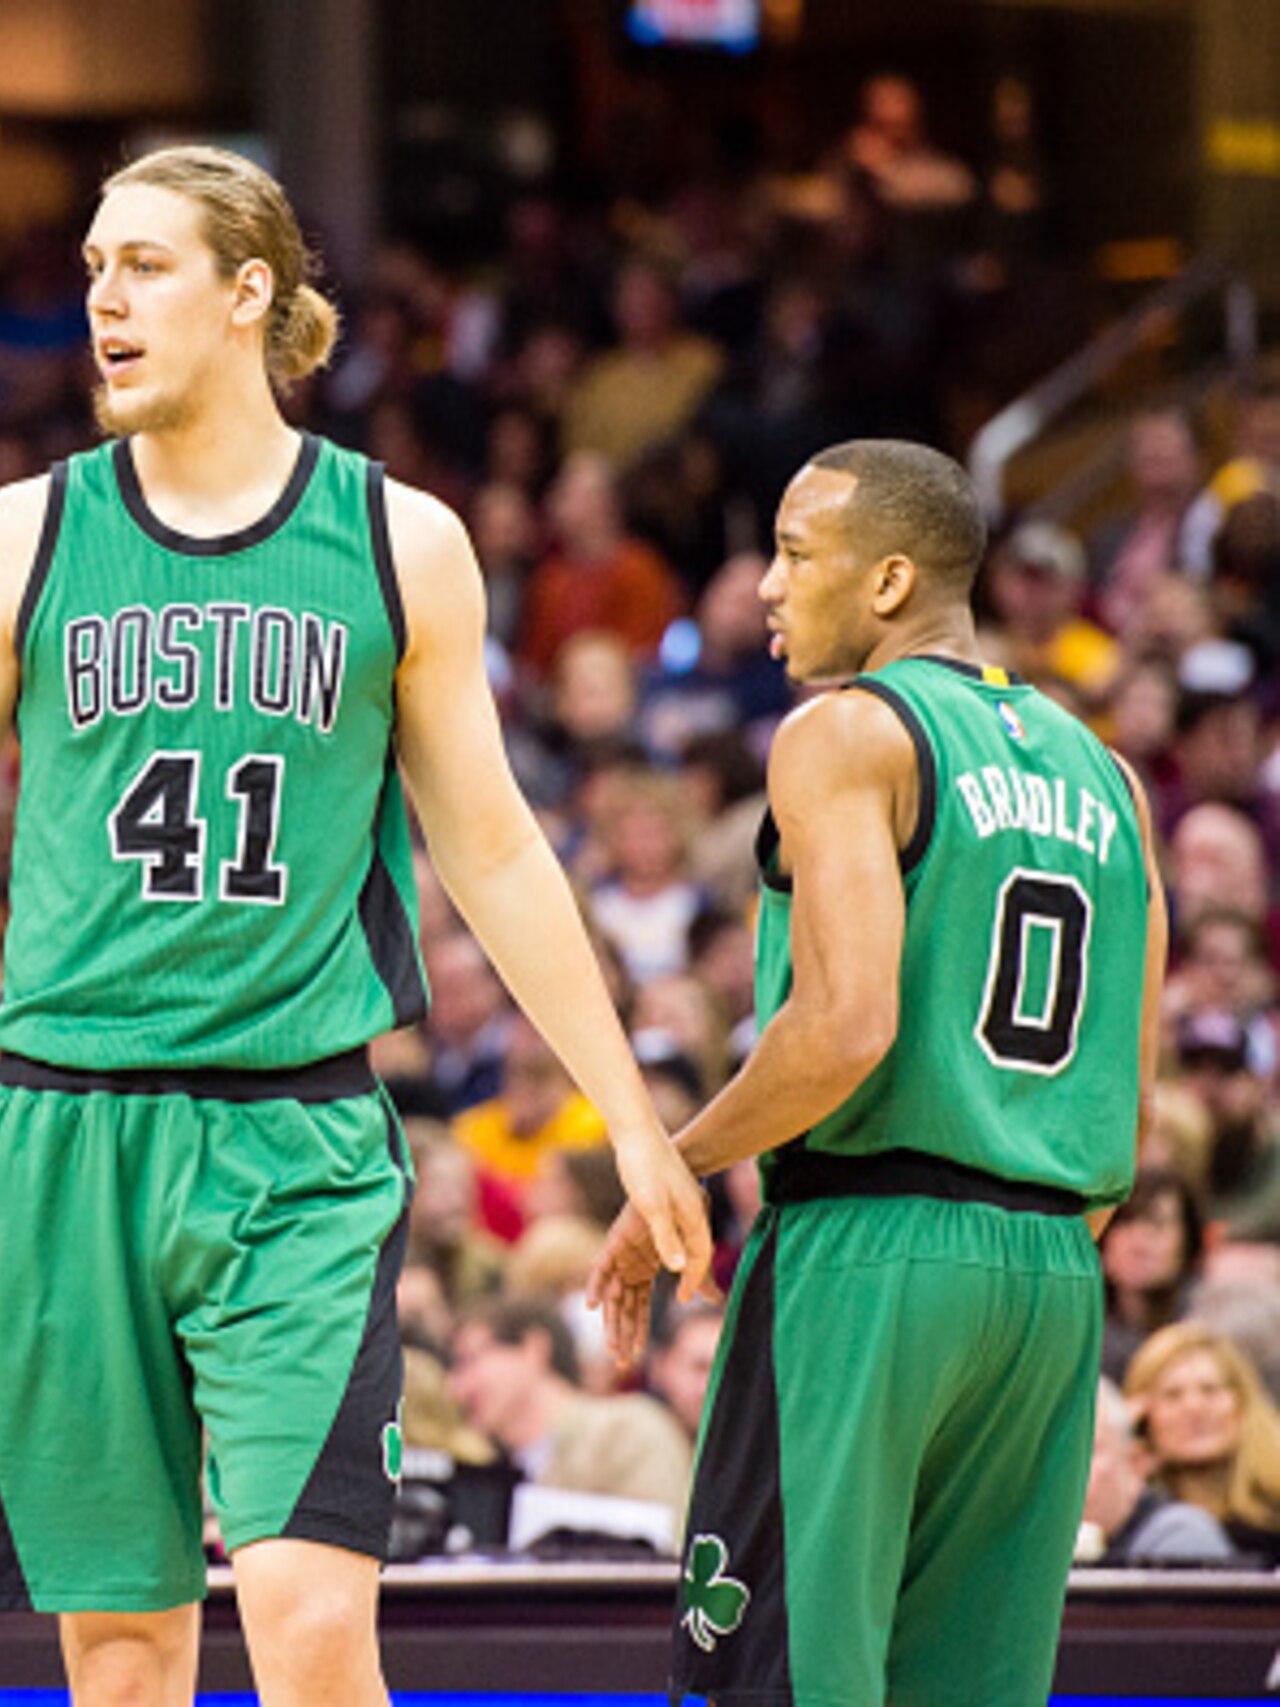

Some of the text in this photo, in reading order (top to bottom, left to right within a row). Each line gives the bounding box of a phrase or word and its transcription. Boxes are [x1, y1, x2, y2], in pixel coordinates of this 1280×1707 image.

[66, 602, 347, 733] BOSTON
[108, 751, 288, 905] 41
[974, 867, 1093, 1076] 0
